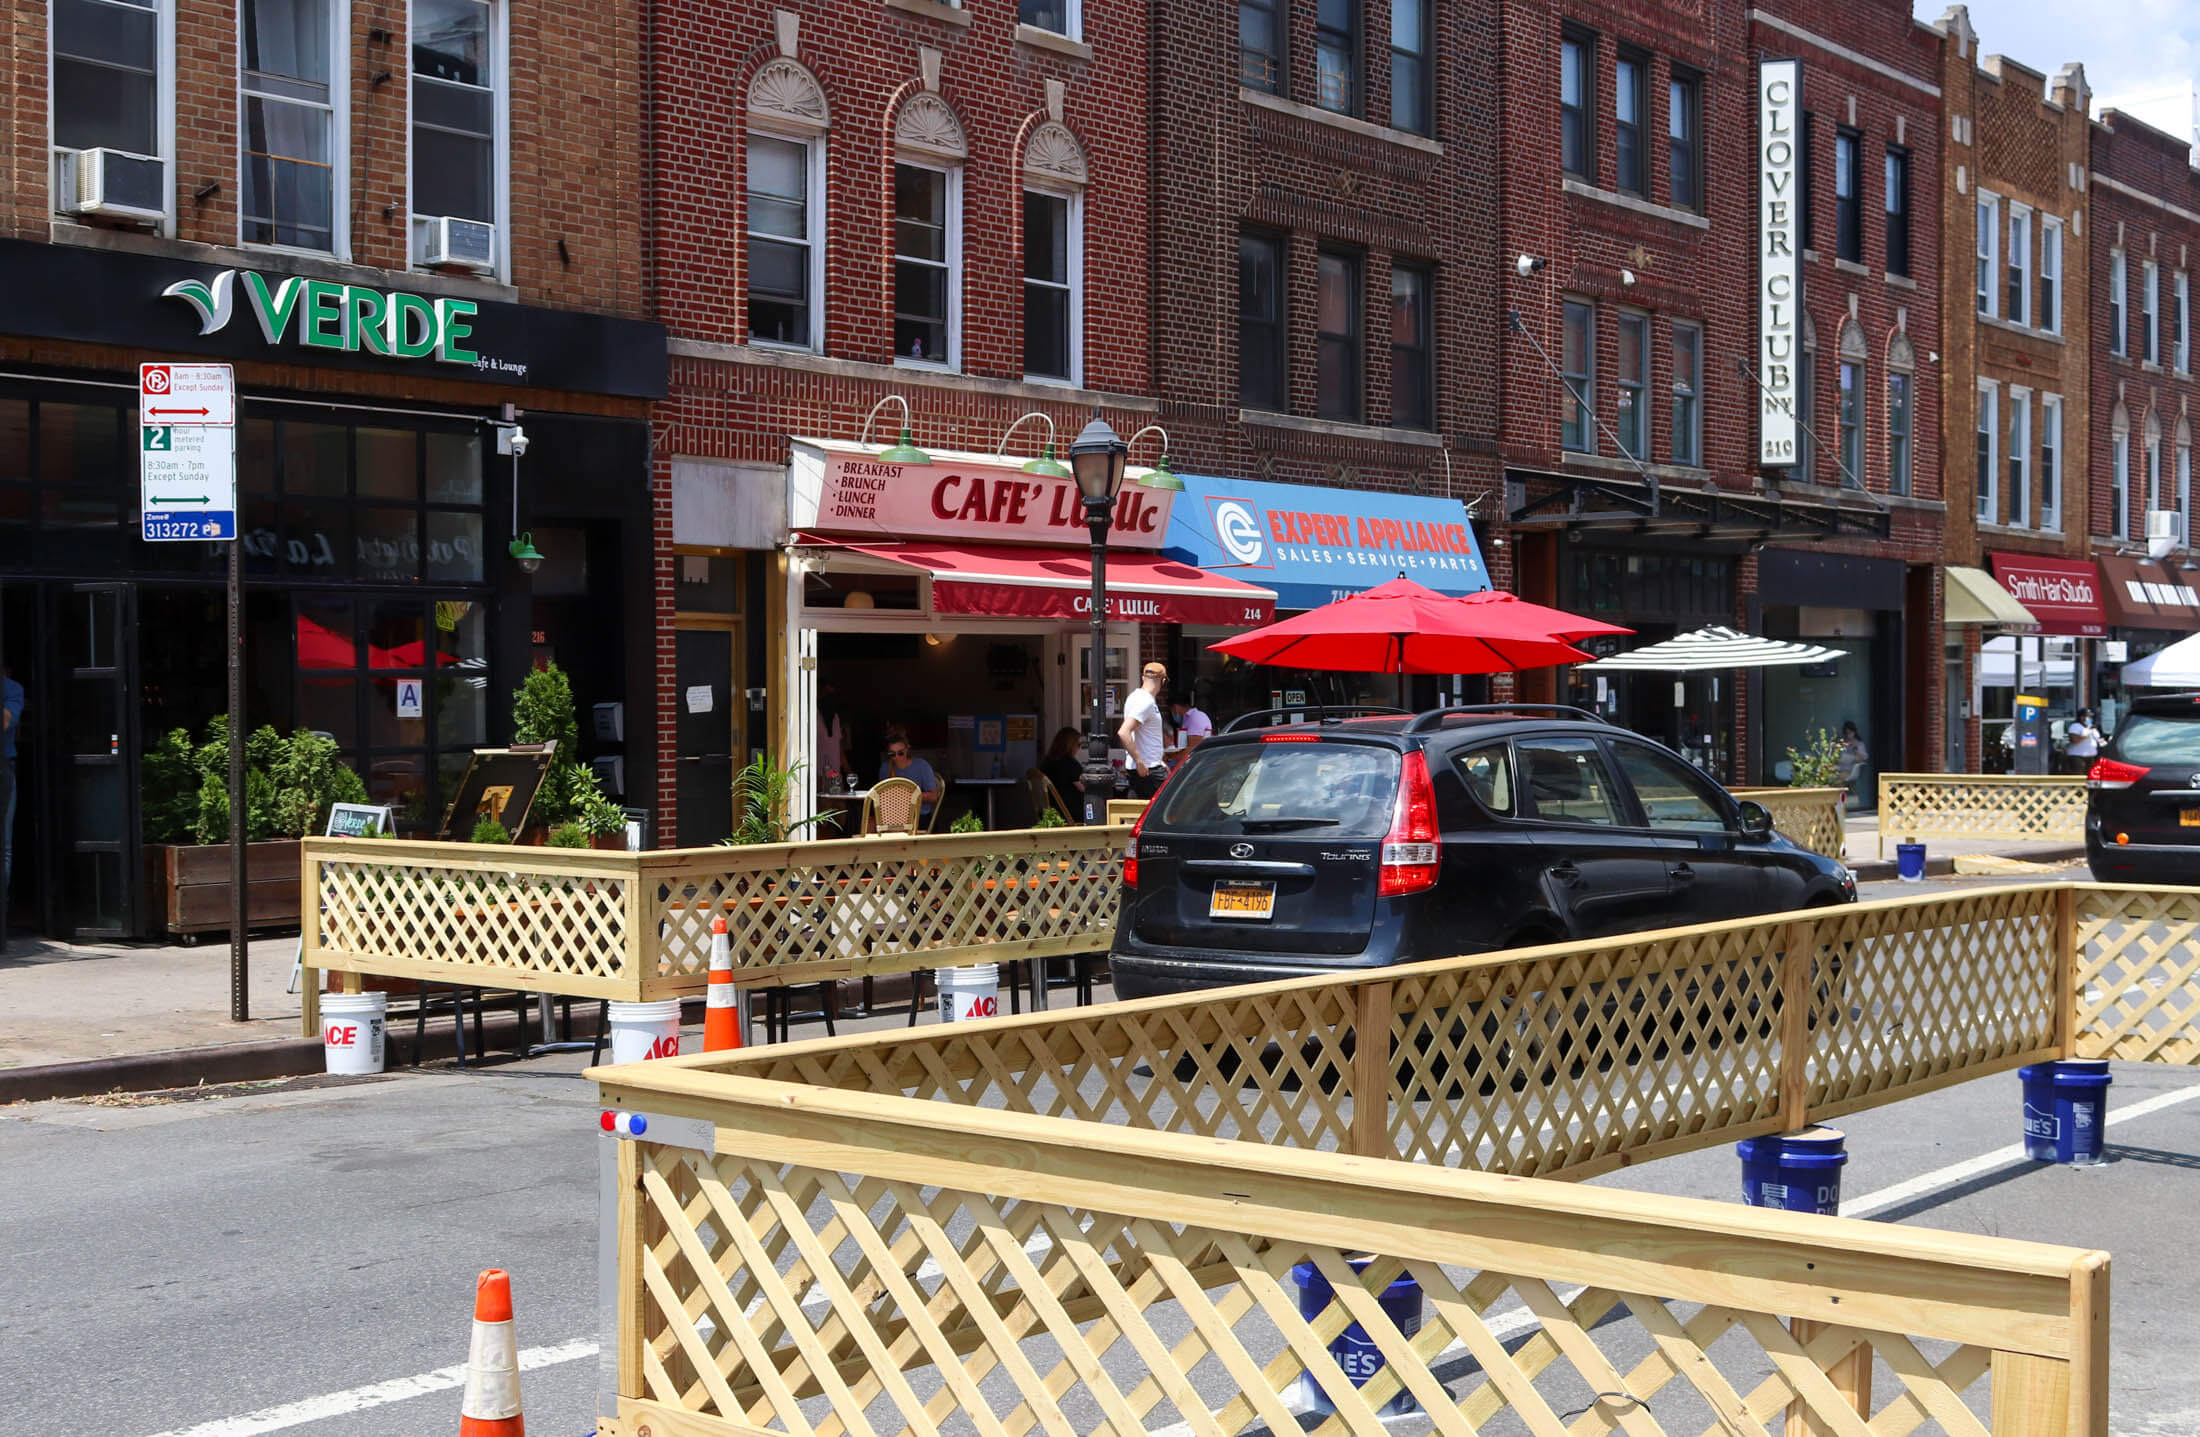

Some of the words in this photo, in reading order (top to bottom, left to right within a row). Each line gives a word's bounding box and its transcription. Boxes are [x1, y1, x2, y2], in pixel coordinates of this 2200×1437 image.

[1765, 80, 1792, 256] CLOVER
[240, 270, 478, 364] VERDE
[1766, 274, 1792, 389] CLUB
[491, 358, 498, 369] &
[499, 359, 527, 376] Lounge
[174, 383, 197, 392] Except
[199, 383, 224, 392] Sunday
[1765, 397, 1792, 414] NY
[150, 426, 164, 449] 2
[174, 445, 201, 453] parking
[1766, 440, 1792, 456] 210
[147, 461, 179, 470] 8:30am
[188, 461, 205, 472] 7pm
[843, 462, 903, 478] BREAKFAST
[147, 472, 176, 482] Except
[178, 472, 209, 483] Sunday
[840, 476, 886, 491] BRUNCH
[838, 491, 876, 504] LUNCH
[835, 505, 876, 519] DINNER
[146, 522, 198, 538] 313272
[1266, 509, 1353, 547] EXPERT
[1356, 517, 1472, 555] APPLIANCE
[1276, 547, 1332, 563] SALES
[1347, 553, 1418, 568] SERVICE
[1429, 557, 1478, 572] PARTS
[2008, 574, 2040, 600] Smith
[2039, 576, 2061, 601] Hair
[2060, 578, 2093, 603] Studio
[1073, 596, 1114, 614] CAE'
[1244, 608, 1262, 620] 214
[531, 631, 546, 643] 216
[401, 684, 418, 706] A
